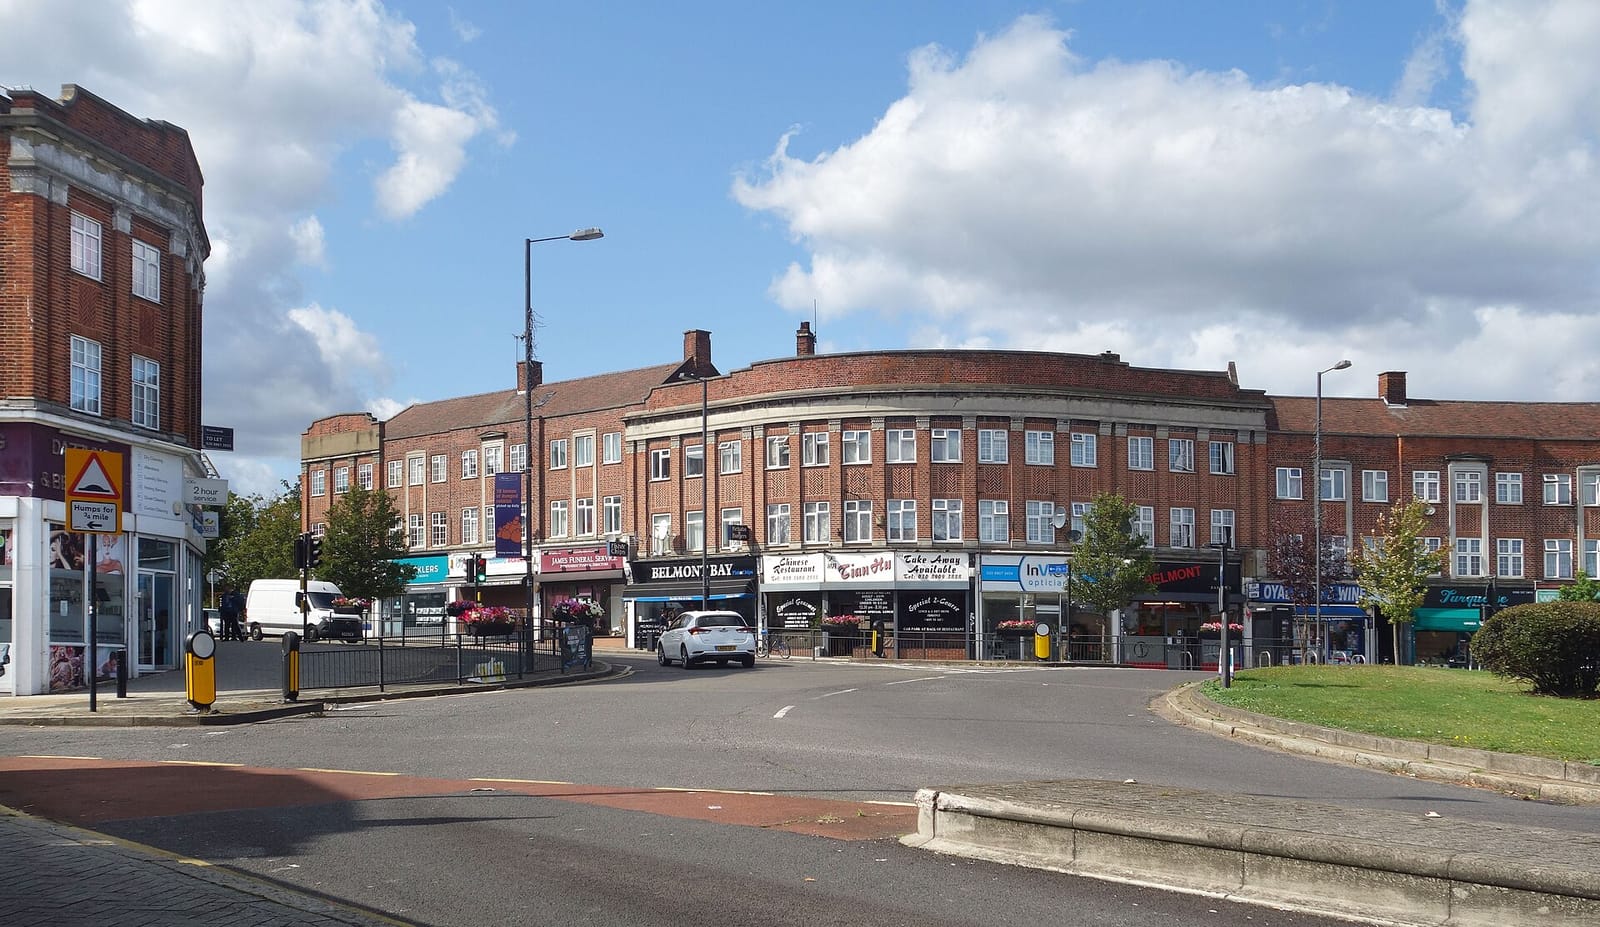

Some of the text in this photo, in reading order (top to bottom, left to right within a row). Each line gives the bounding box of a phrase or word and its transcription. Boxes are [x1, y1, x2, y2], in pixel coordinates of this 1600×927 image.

[194, 486, 200, 494] 2
[74, 504, 100, 512] Humps
[552, 557, 568, 566] JAMES
[780, 558, 808, 566] Chinese
[904, 554, 960, 566] Take Away
[710, 564, 733, 577] BAY
[773, 565, 815, 574] Restaurant
[838, 564, 869, 580] Tian
[908, 564, 956, 574] Available
[1144, 565, 1200, 584] BELMONT
[1440, 589, 1509, 608] Turquose
[908, 597, 930, 612] Special
